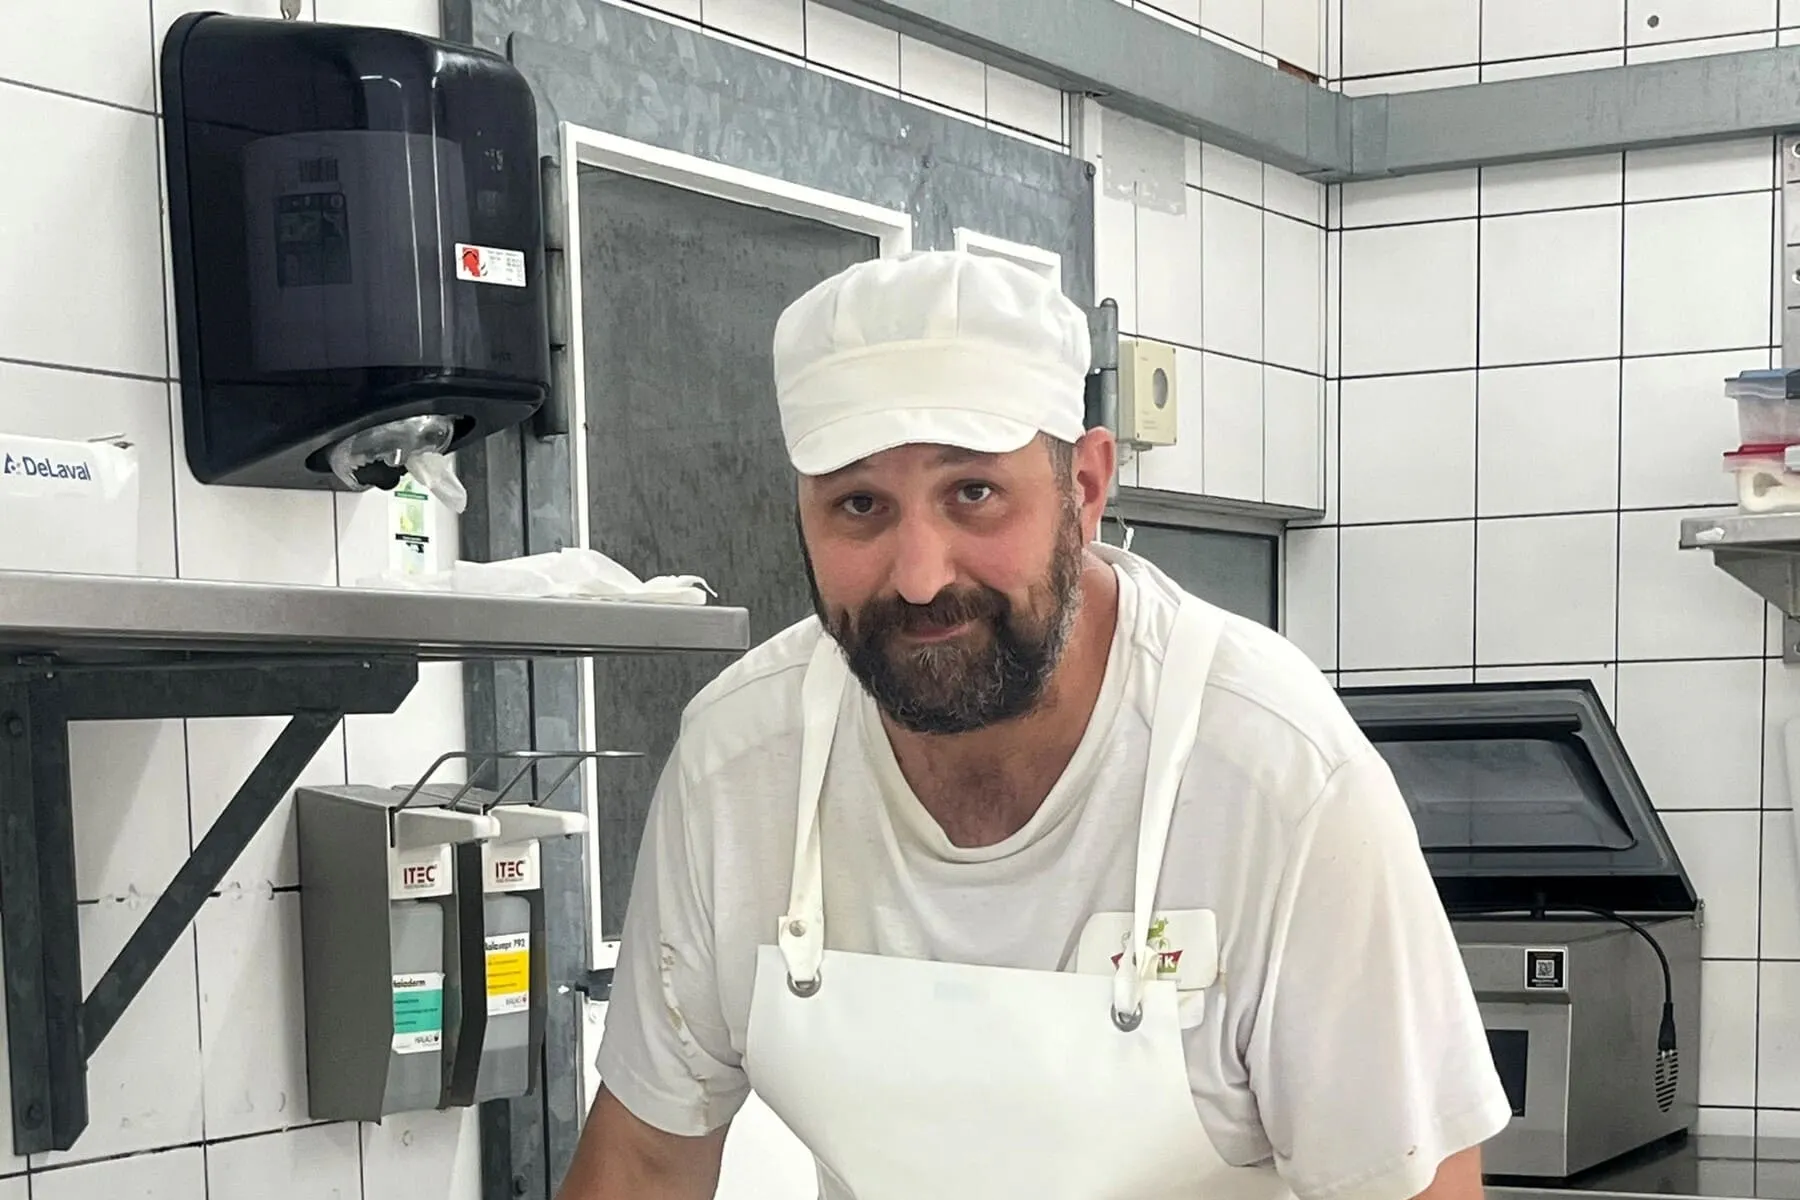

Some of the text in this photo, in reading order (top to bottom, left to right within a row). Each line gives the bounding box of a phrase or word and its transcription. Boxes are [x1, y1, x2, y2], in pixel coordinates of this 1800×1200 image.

[22, 456, 92, 481] DeLaval
[403, 865, 436, 885] ITEC
[495, 860, 525, 878] ITEC
